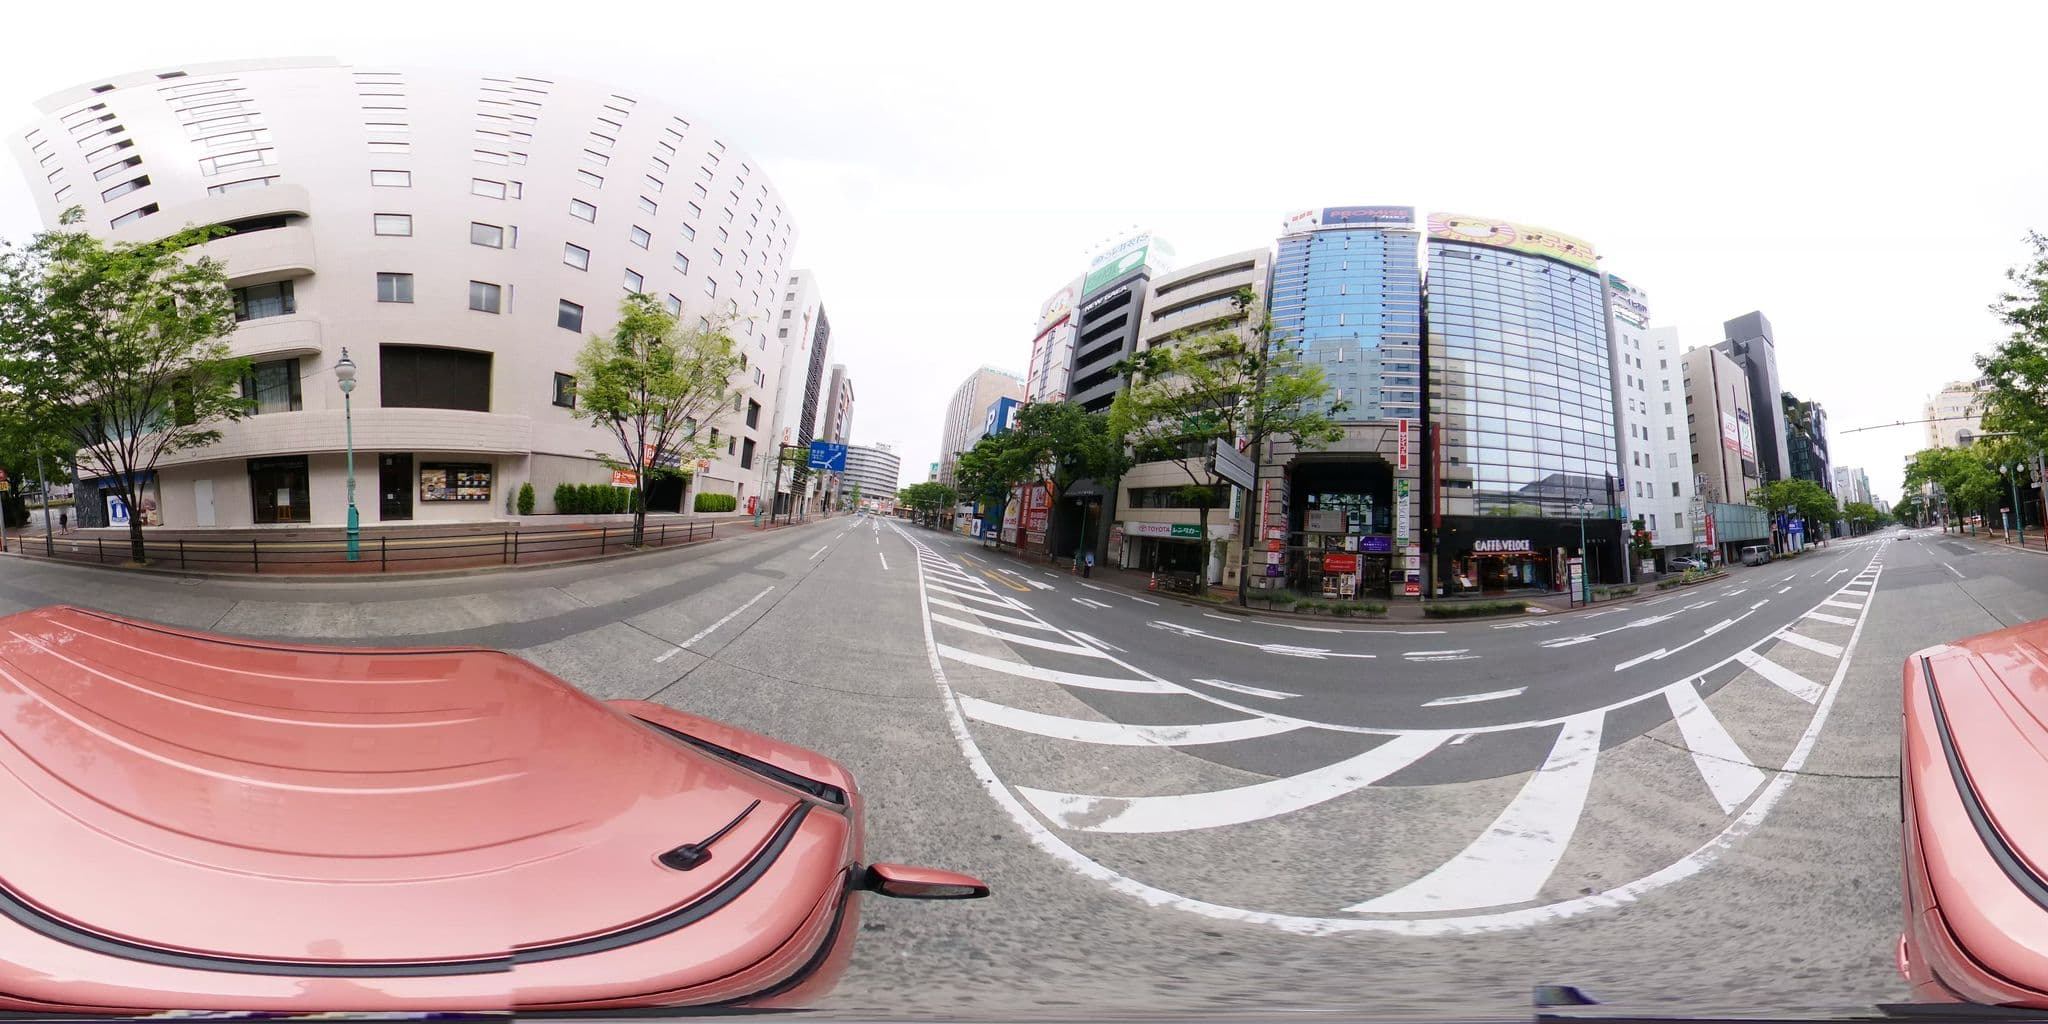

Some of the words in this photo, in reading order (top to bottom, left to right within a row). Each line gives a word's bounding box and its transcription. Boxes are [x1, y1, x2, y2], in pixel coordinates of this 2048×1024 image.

[1330, 209, 1408, 218] PROMISE
[1084, 298, 1104, 312] NEW
[1502, 539, 1529, 551] VELOCE
